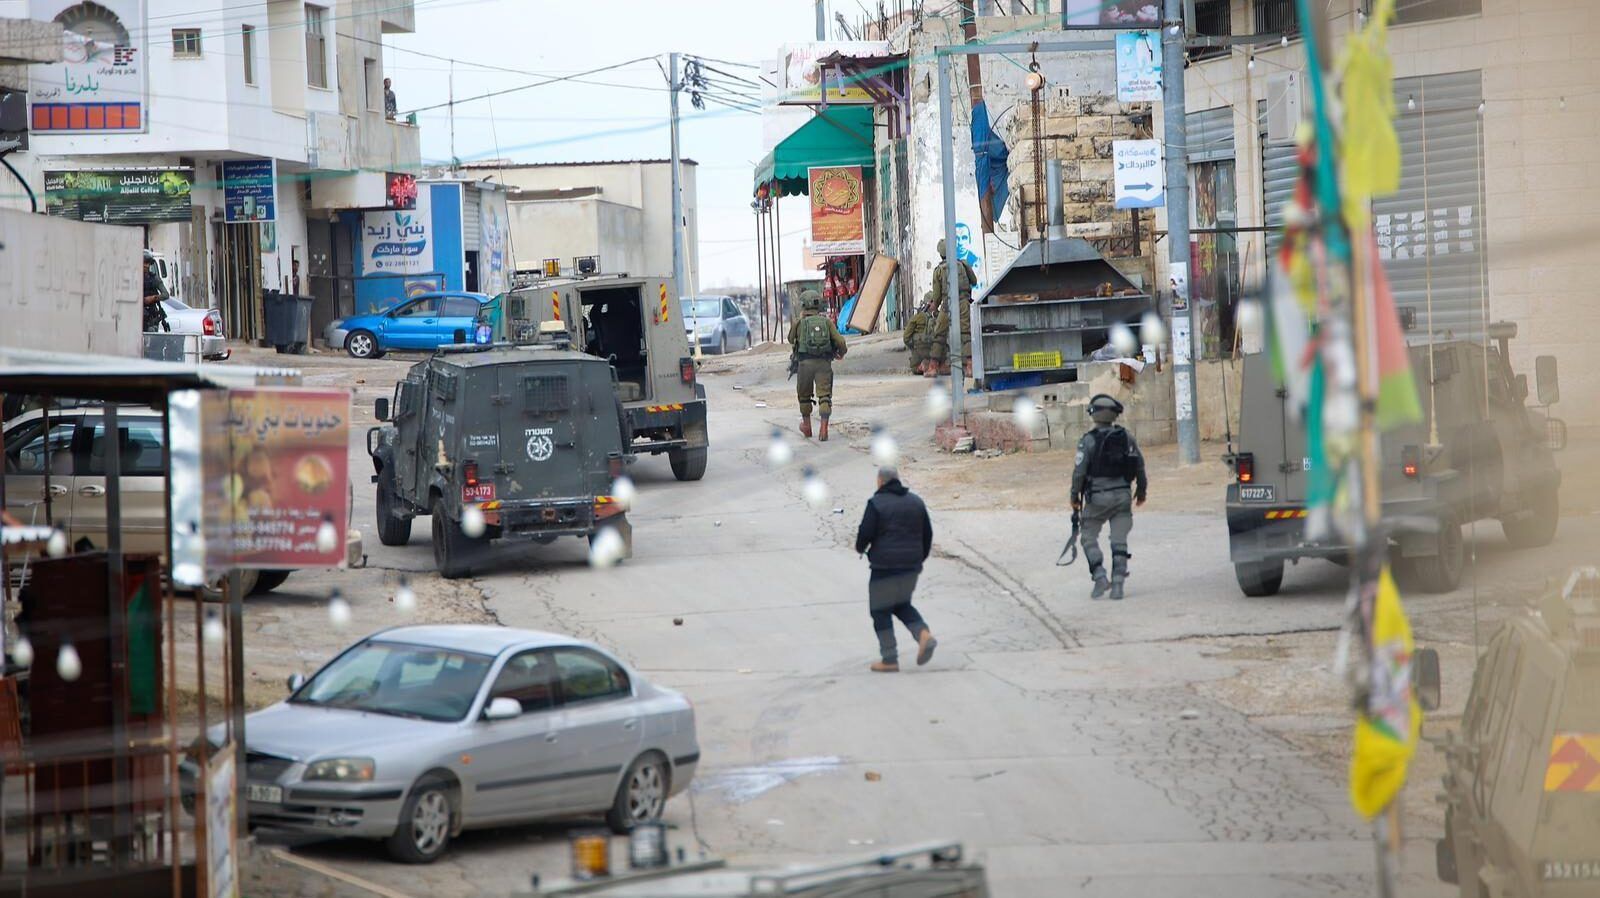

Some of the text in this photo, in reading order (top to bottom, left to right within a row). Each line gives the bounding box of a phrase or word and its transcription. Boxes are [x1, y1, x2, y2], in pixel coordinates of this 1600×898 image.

[368, 221, 425, 241] بني زيد
[376, 244, 400, 254] ماركت
[525, 427, 553, 436] משטרה
